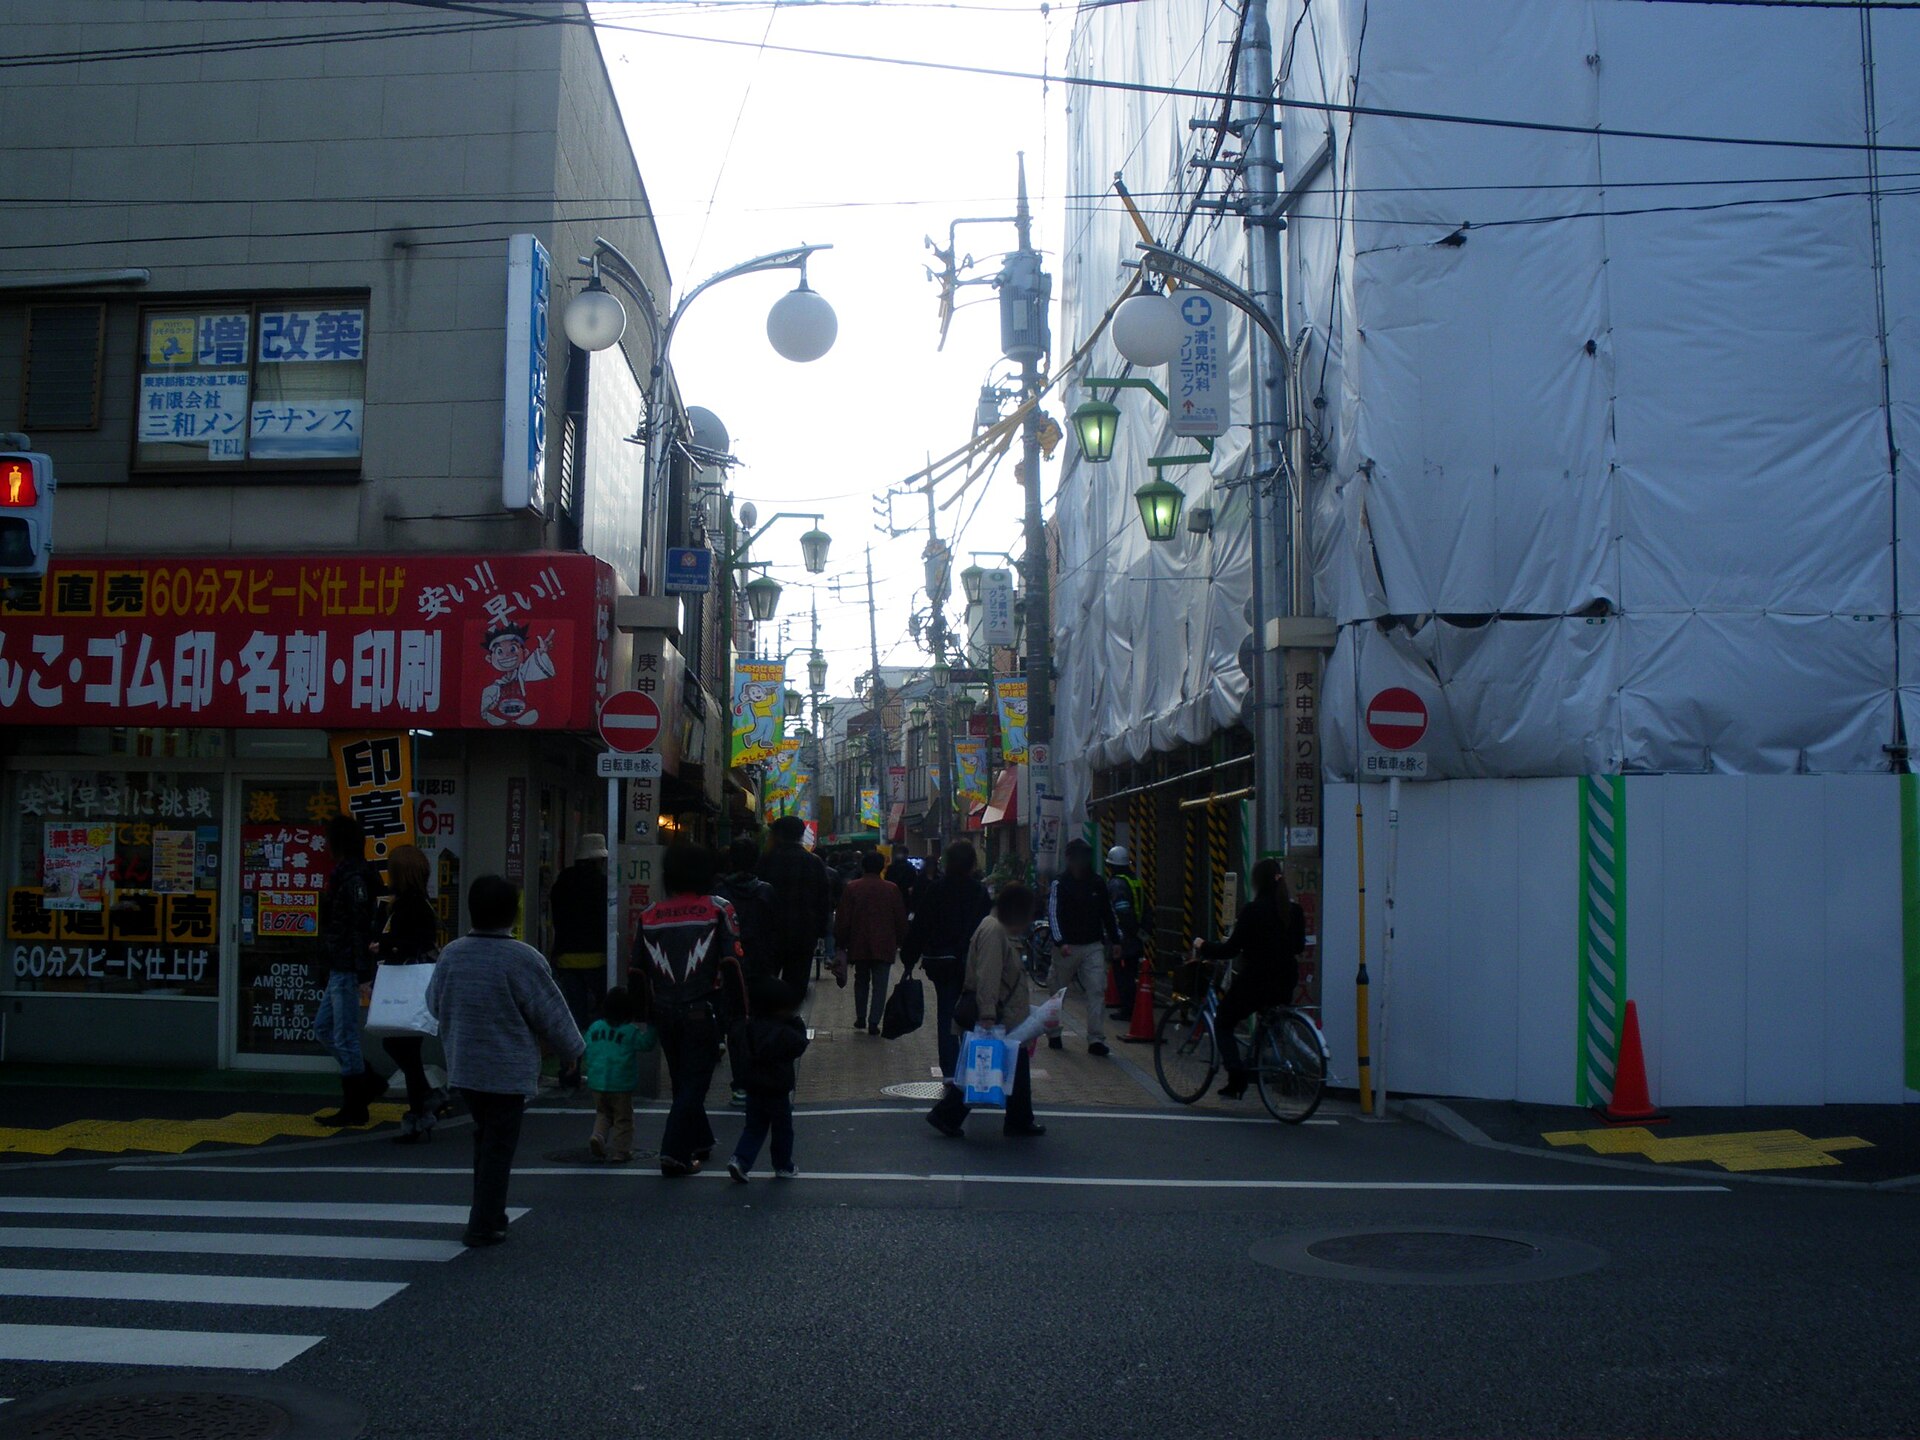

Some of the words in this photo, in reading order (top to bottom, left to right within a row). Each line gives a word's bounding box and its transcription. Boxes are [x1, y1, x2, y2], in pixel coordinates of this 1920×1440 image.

[200, 311, 361, 364] 増改築
[148, 390, 222, 410] 有限会社
[146, 407, 354, 437] 三和メンテナンス
[213, 438, 243, 455] TEL
[151, 566, 406, 617] 60分スピード仕上げ
[1295, 672, 1314, 825] 庚申通り商店街
[602, 758, 658, 773] 自転車を除く
[1367, 756, 1424, 772] 自転車を除く
[247, 790, 337, 822] 激安
[260, 873, 324, 888] 高円寺店
[271, 893, 316, 906] 電池交換
[14, 945, 208, 981] 60分スピード仕上げ
[270, 963, 309, 977] OPEN
[274, 988, 325, 1001] PM7:30
